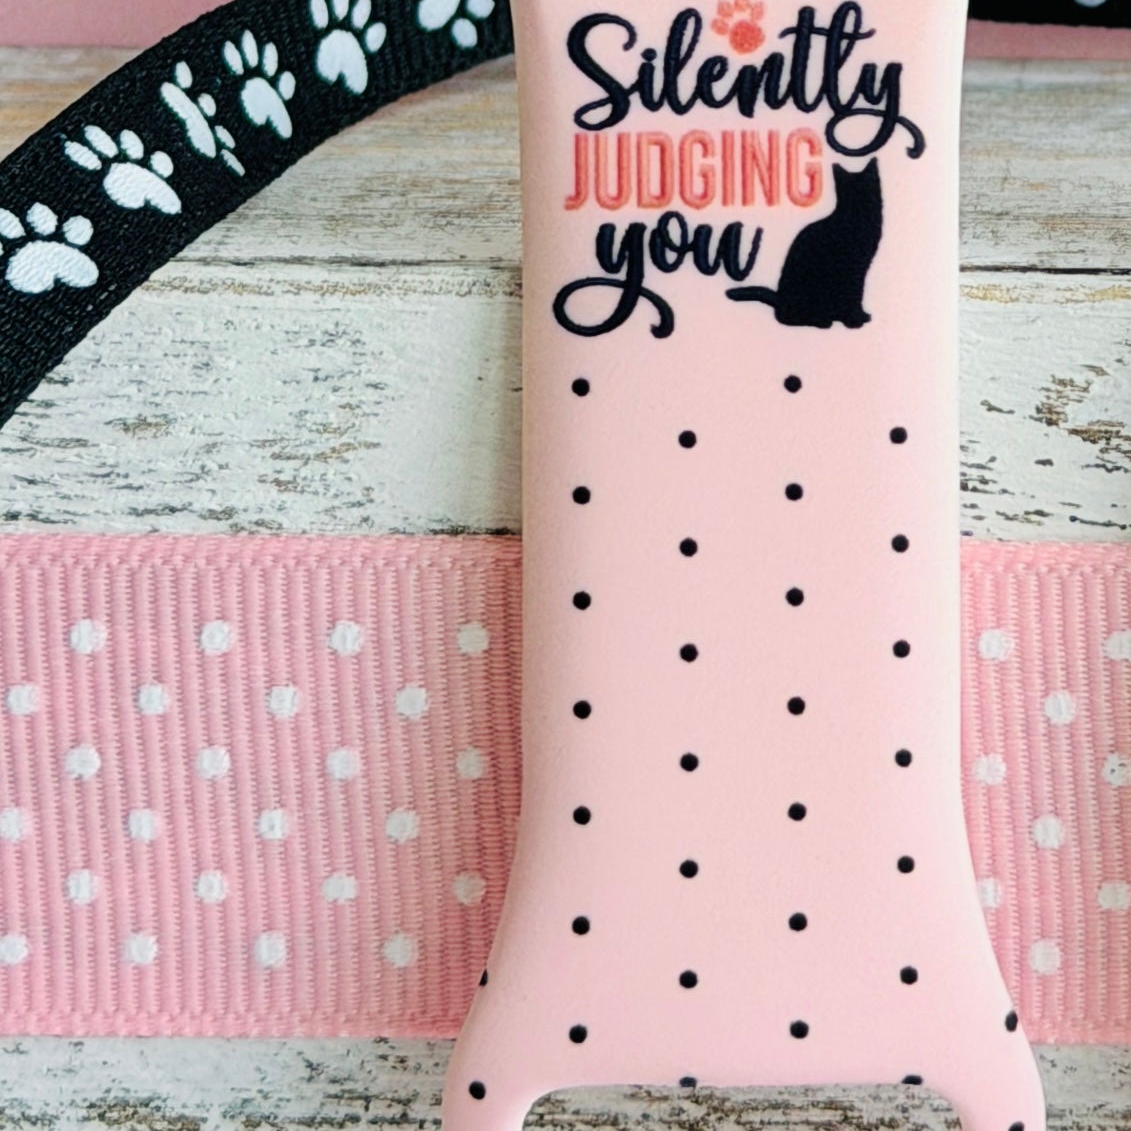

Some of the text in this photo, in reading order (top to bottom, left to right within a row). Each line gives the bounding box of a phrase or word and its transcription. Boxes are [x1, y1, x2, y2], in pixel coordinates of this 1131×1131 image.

[567, 0, 926, 159] Silently
[563, 127, 823, 211] JUDGING
[552, 211, 763, 339] you
